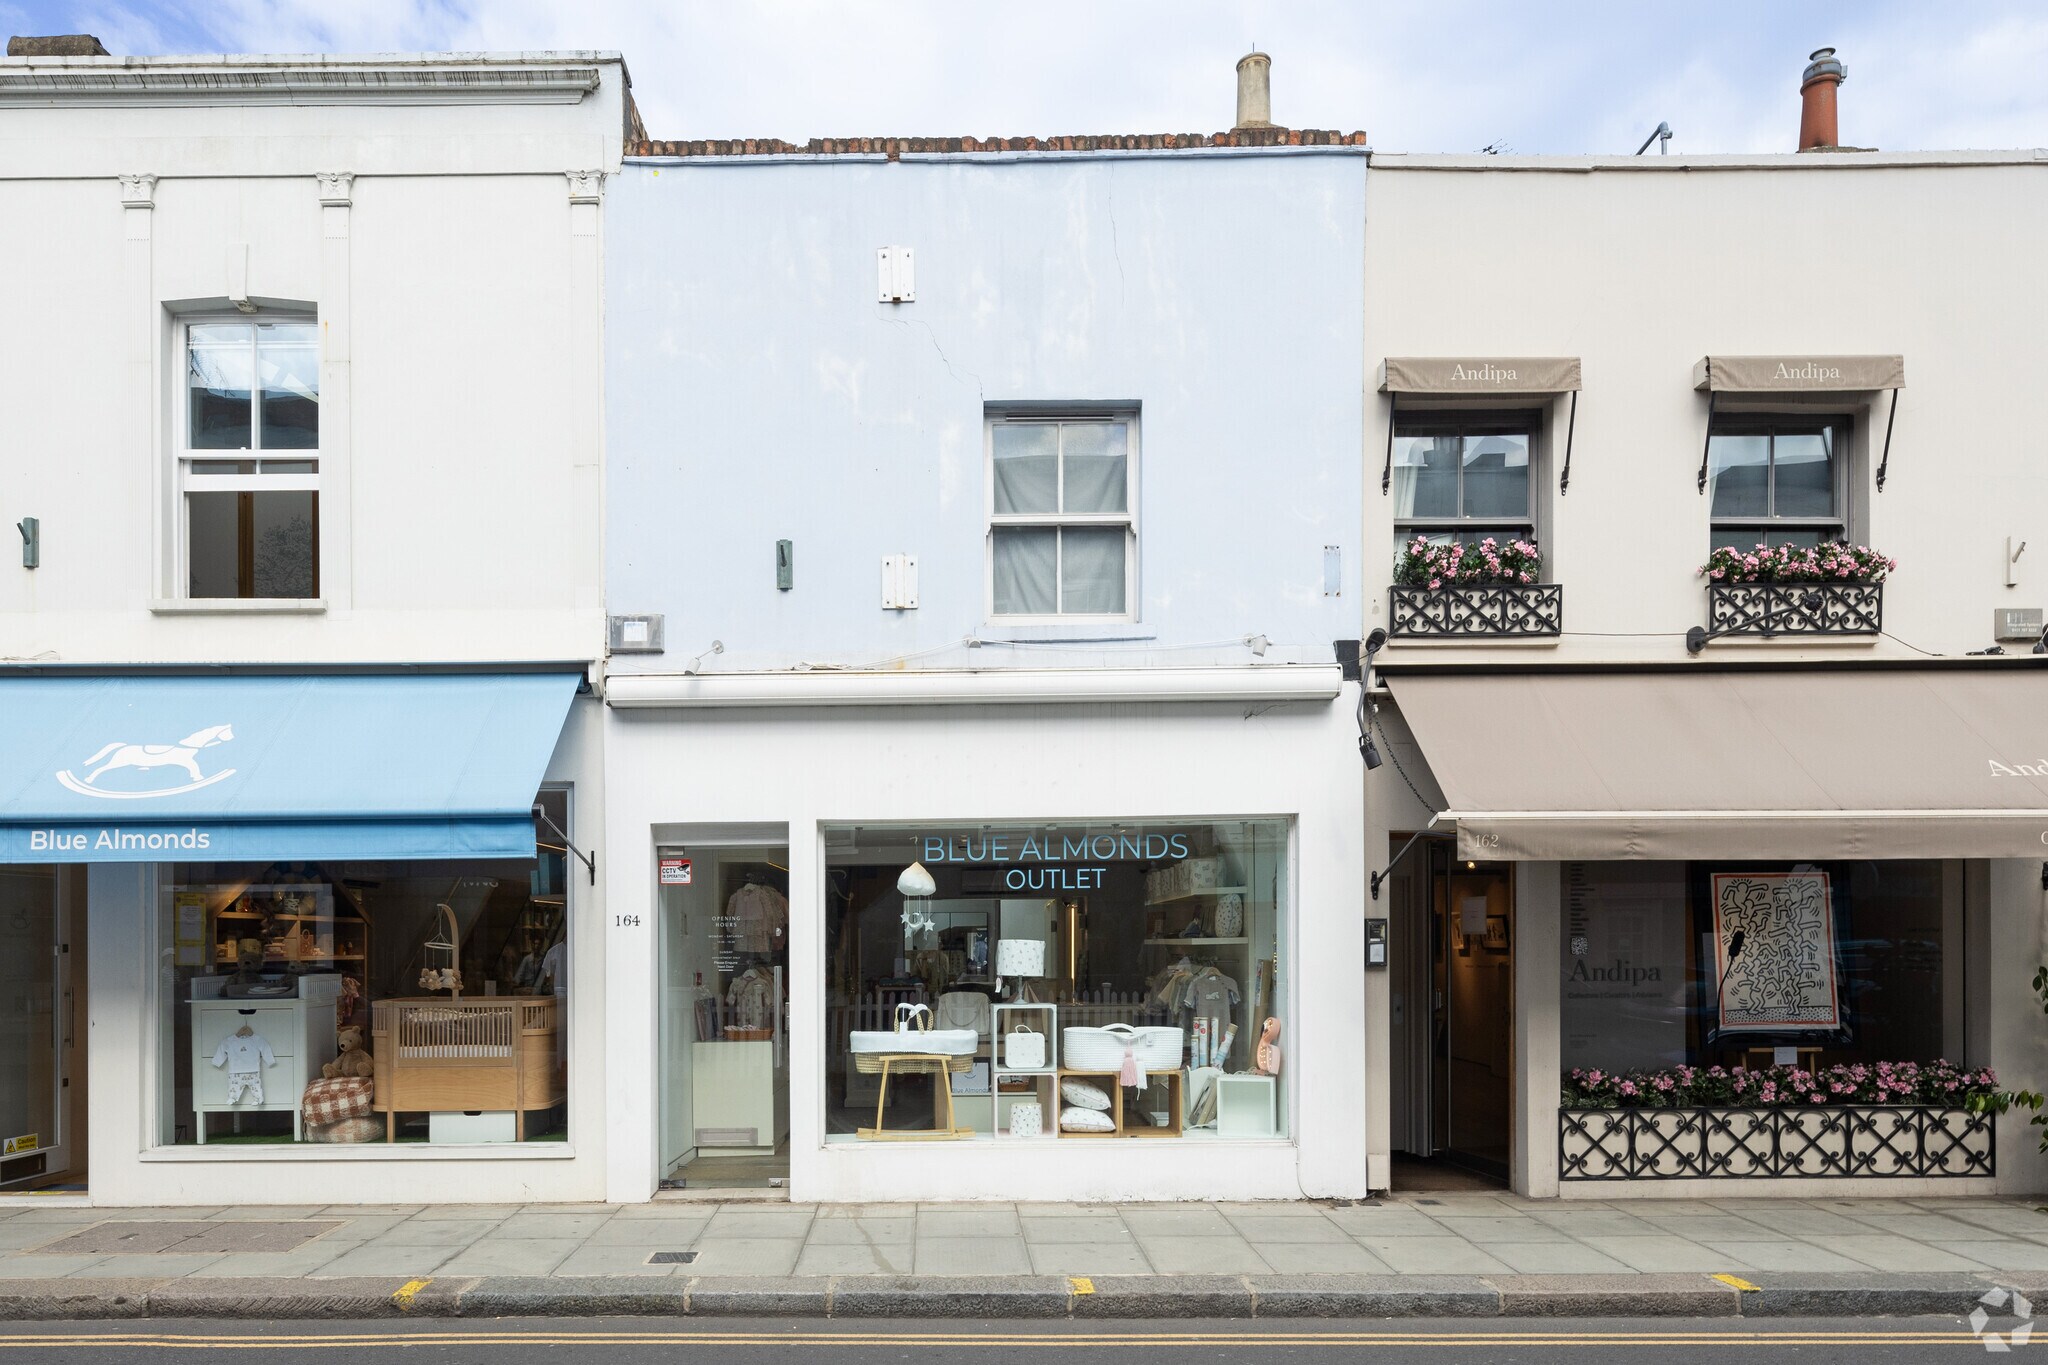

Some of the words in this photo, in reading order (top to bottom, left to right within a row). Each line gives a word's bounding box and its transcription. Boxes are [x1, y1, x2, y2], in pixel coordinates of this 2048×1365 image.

[1451, 363, 1518, 384] Andipa
[1773, 361, 1841, 382] Andipa
[30, 829, 88, 850] Blue
[94, 828, 211, 850] Almonds
[924, 836, 1010, 862] BLUE
[1018, 833, 1189, 861] ALMONDS
[1475, 834, 1499, 848] 162
[1006, 868, 1106, 890] OUTLET
[616, 914, 641, 927] 164
[1567, 959, 1662, 987] Andipa
